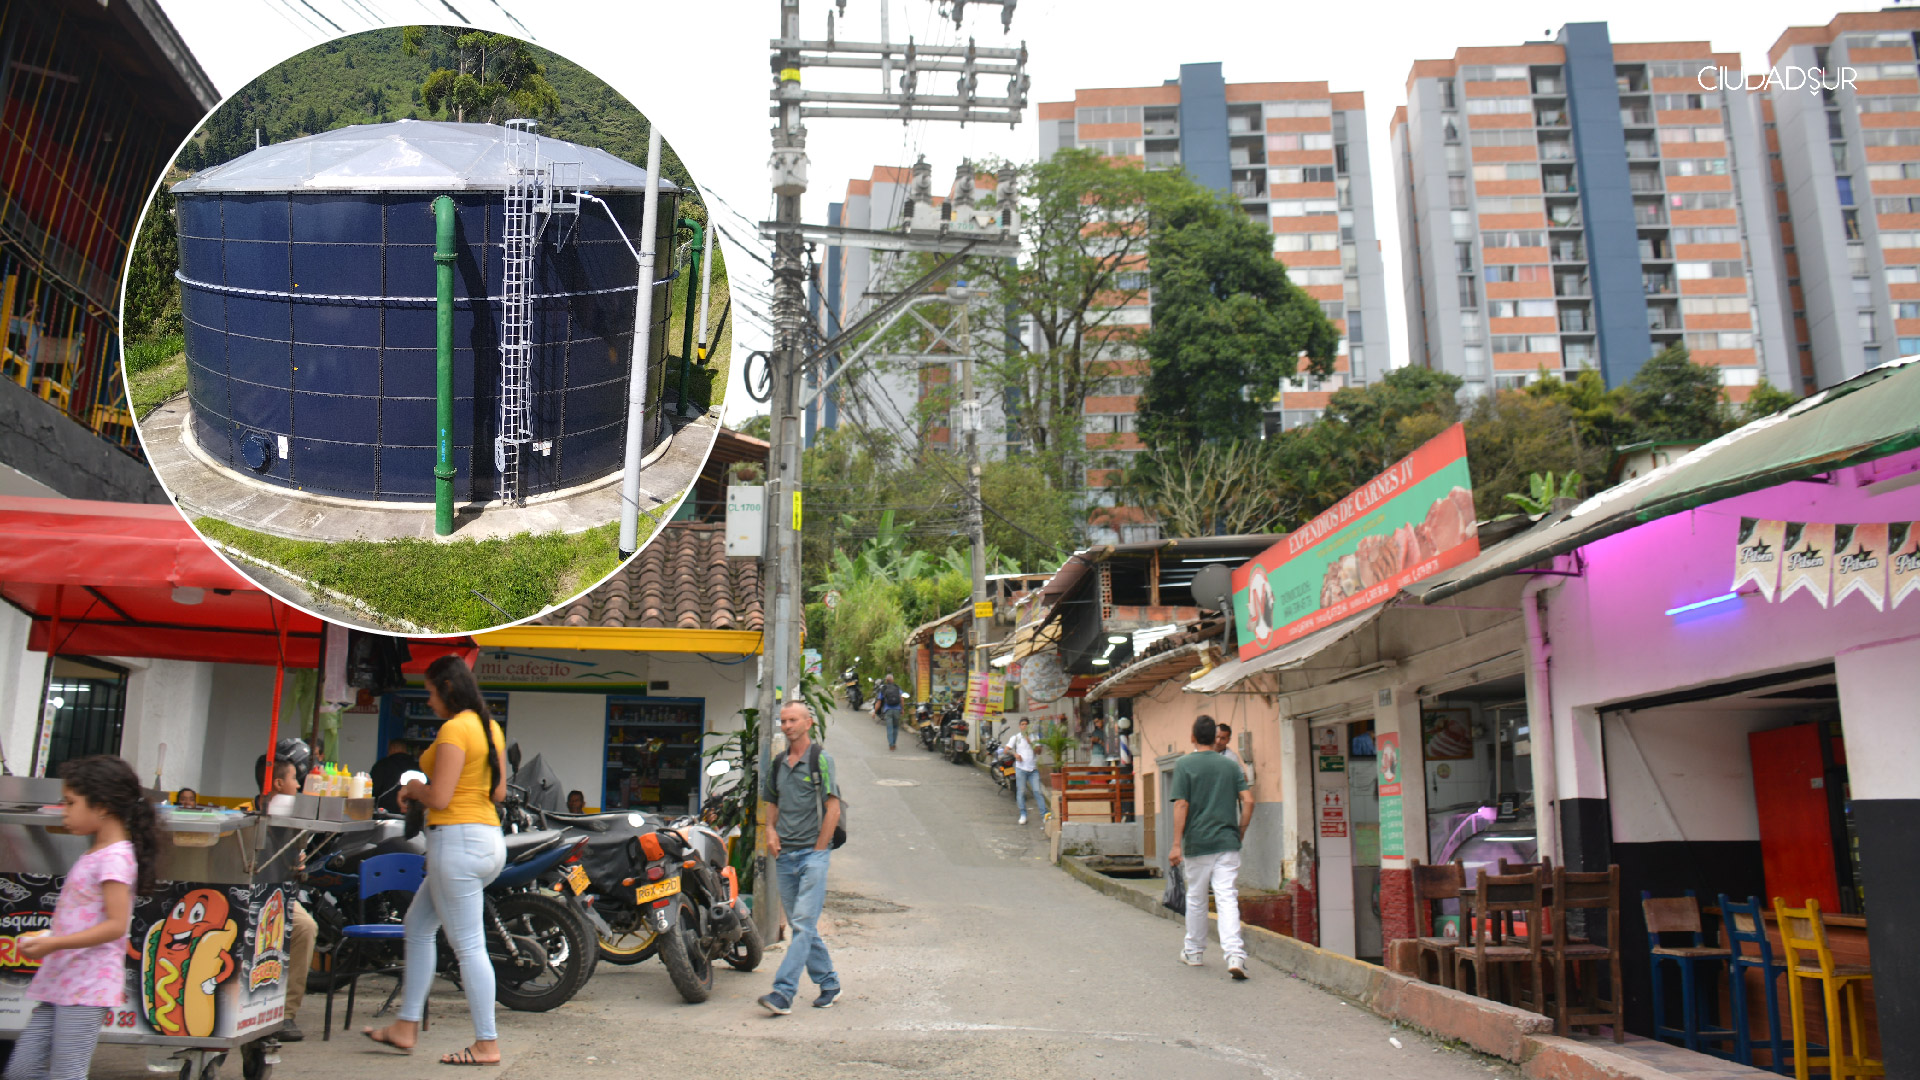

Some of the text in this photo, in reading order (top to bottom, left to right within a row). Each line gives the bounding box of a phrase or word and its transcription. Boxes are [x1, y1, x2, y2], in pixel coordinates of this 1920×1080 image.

[728, 503, 740, 512] CL
[1288, 509, 1339, 555] EXPENDIOS
[1339, 497, 1356, 523] DE
[1355, 468, 1399, 512] CARNES
[1740, 546, 1774, 564] Pilsen
[1788, 553, 1824, 571] Pilsen
[1840, 555, 1878, 575] Pilsen
[481, 660, 570, 677] mi cafecito
[0, 912, 53, 931] squin
[118, 1011, 137, 1028] 33
